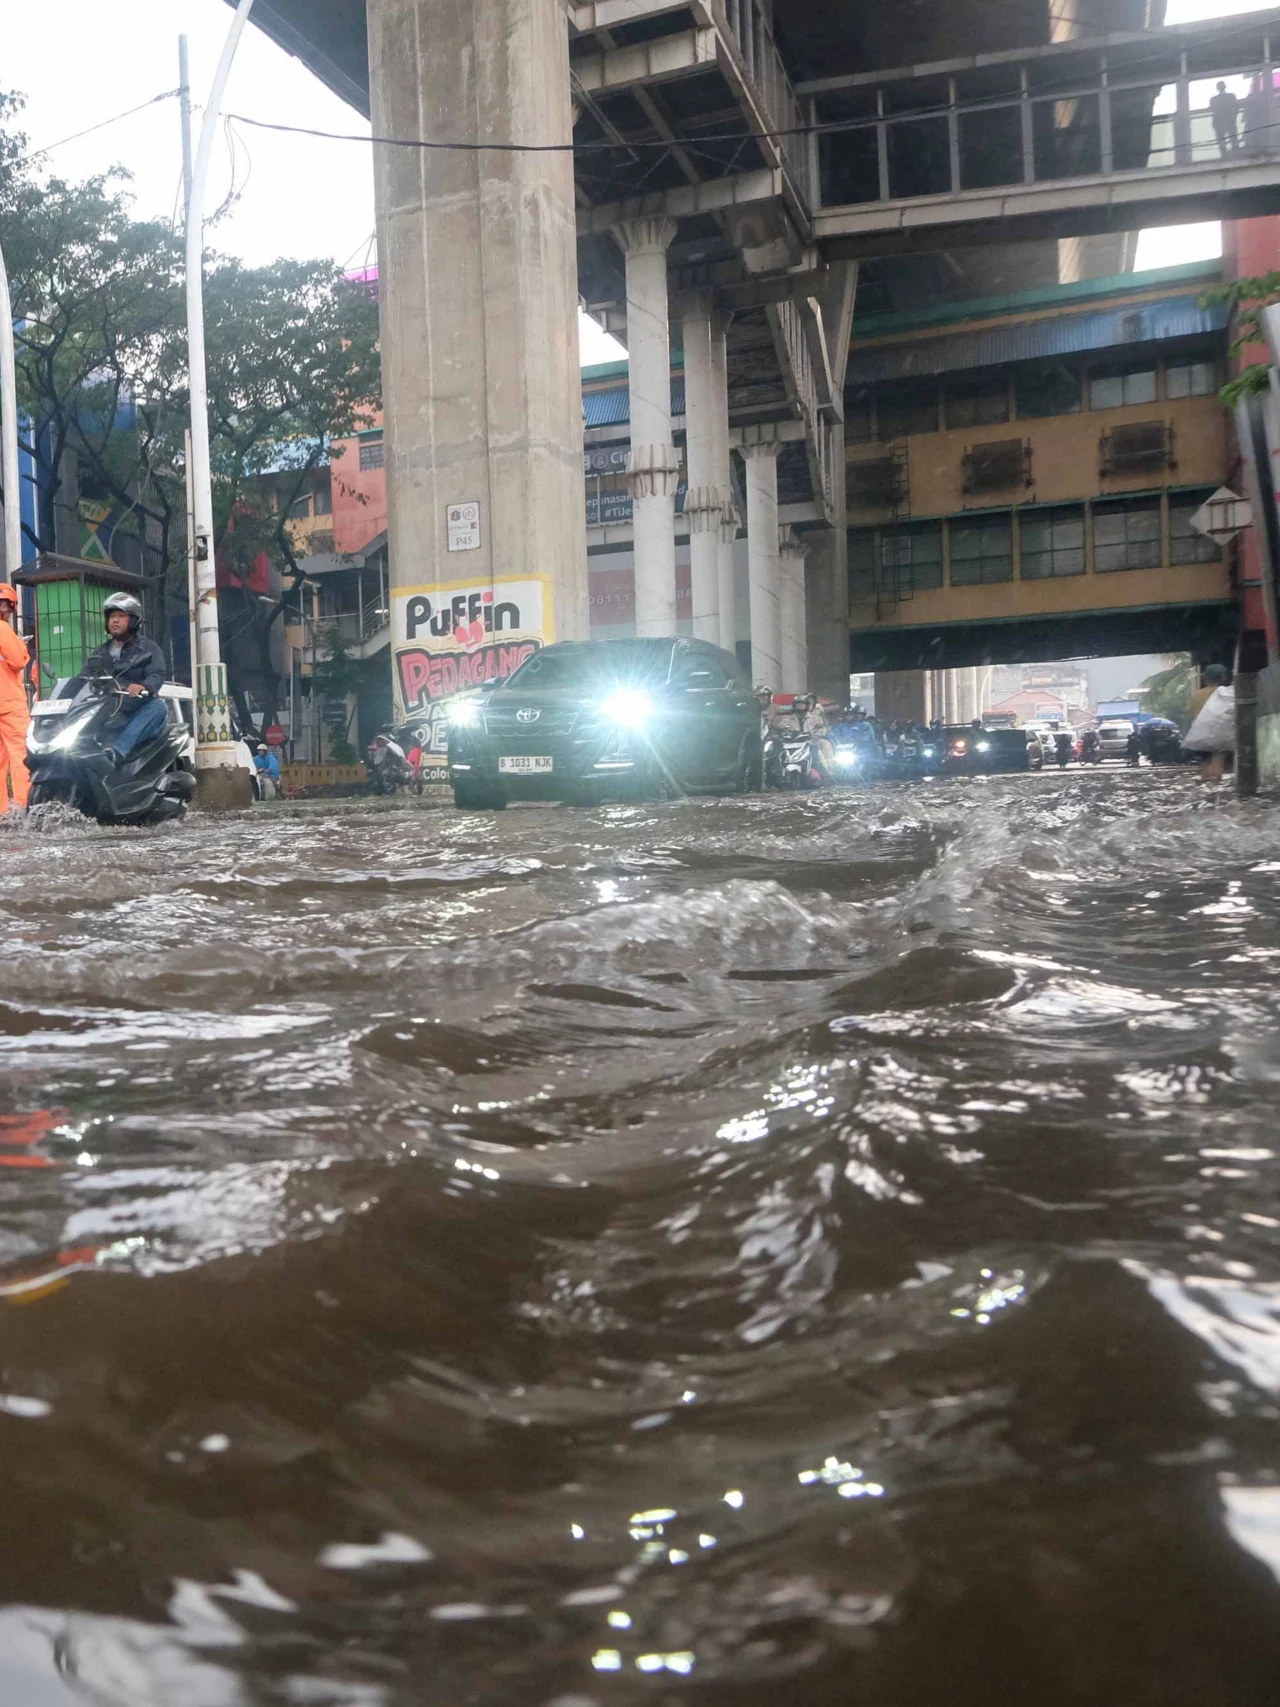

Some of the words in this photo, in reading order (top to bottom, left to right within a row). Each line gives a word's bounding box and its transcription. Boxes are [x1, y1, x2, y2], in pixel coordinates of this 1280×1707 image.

[456, 535, 473, 546] P45
[500, 758, 507, 768] B
[509, 757, 531, 768] 1031
[534, 757, 552, 768] NJK
